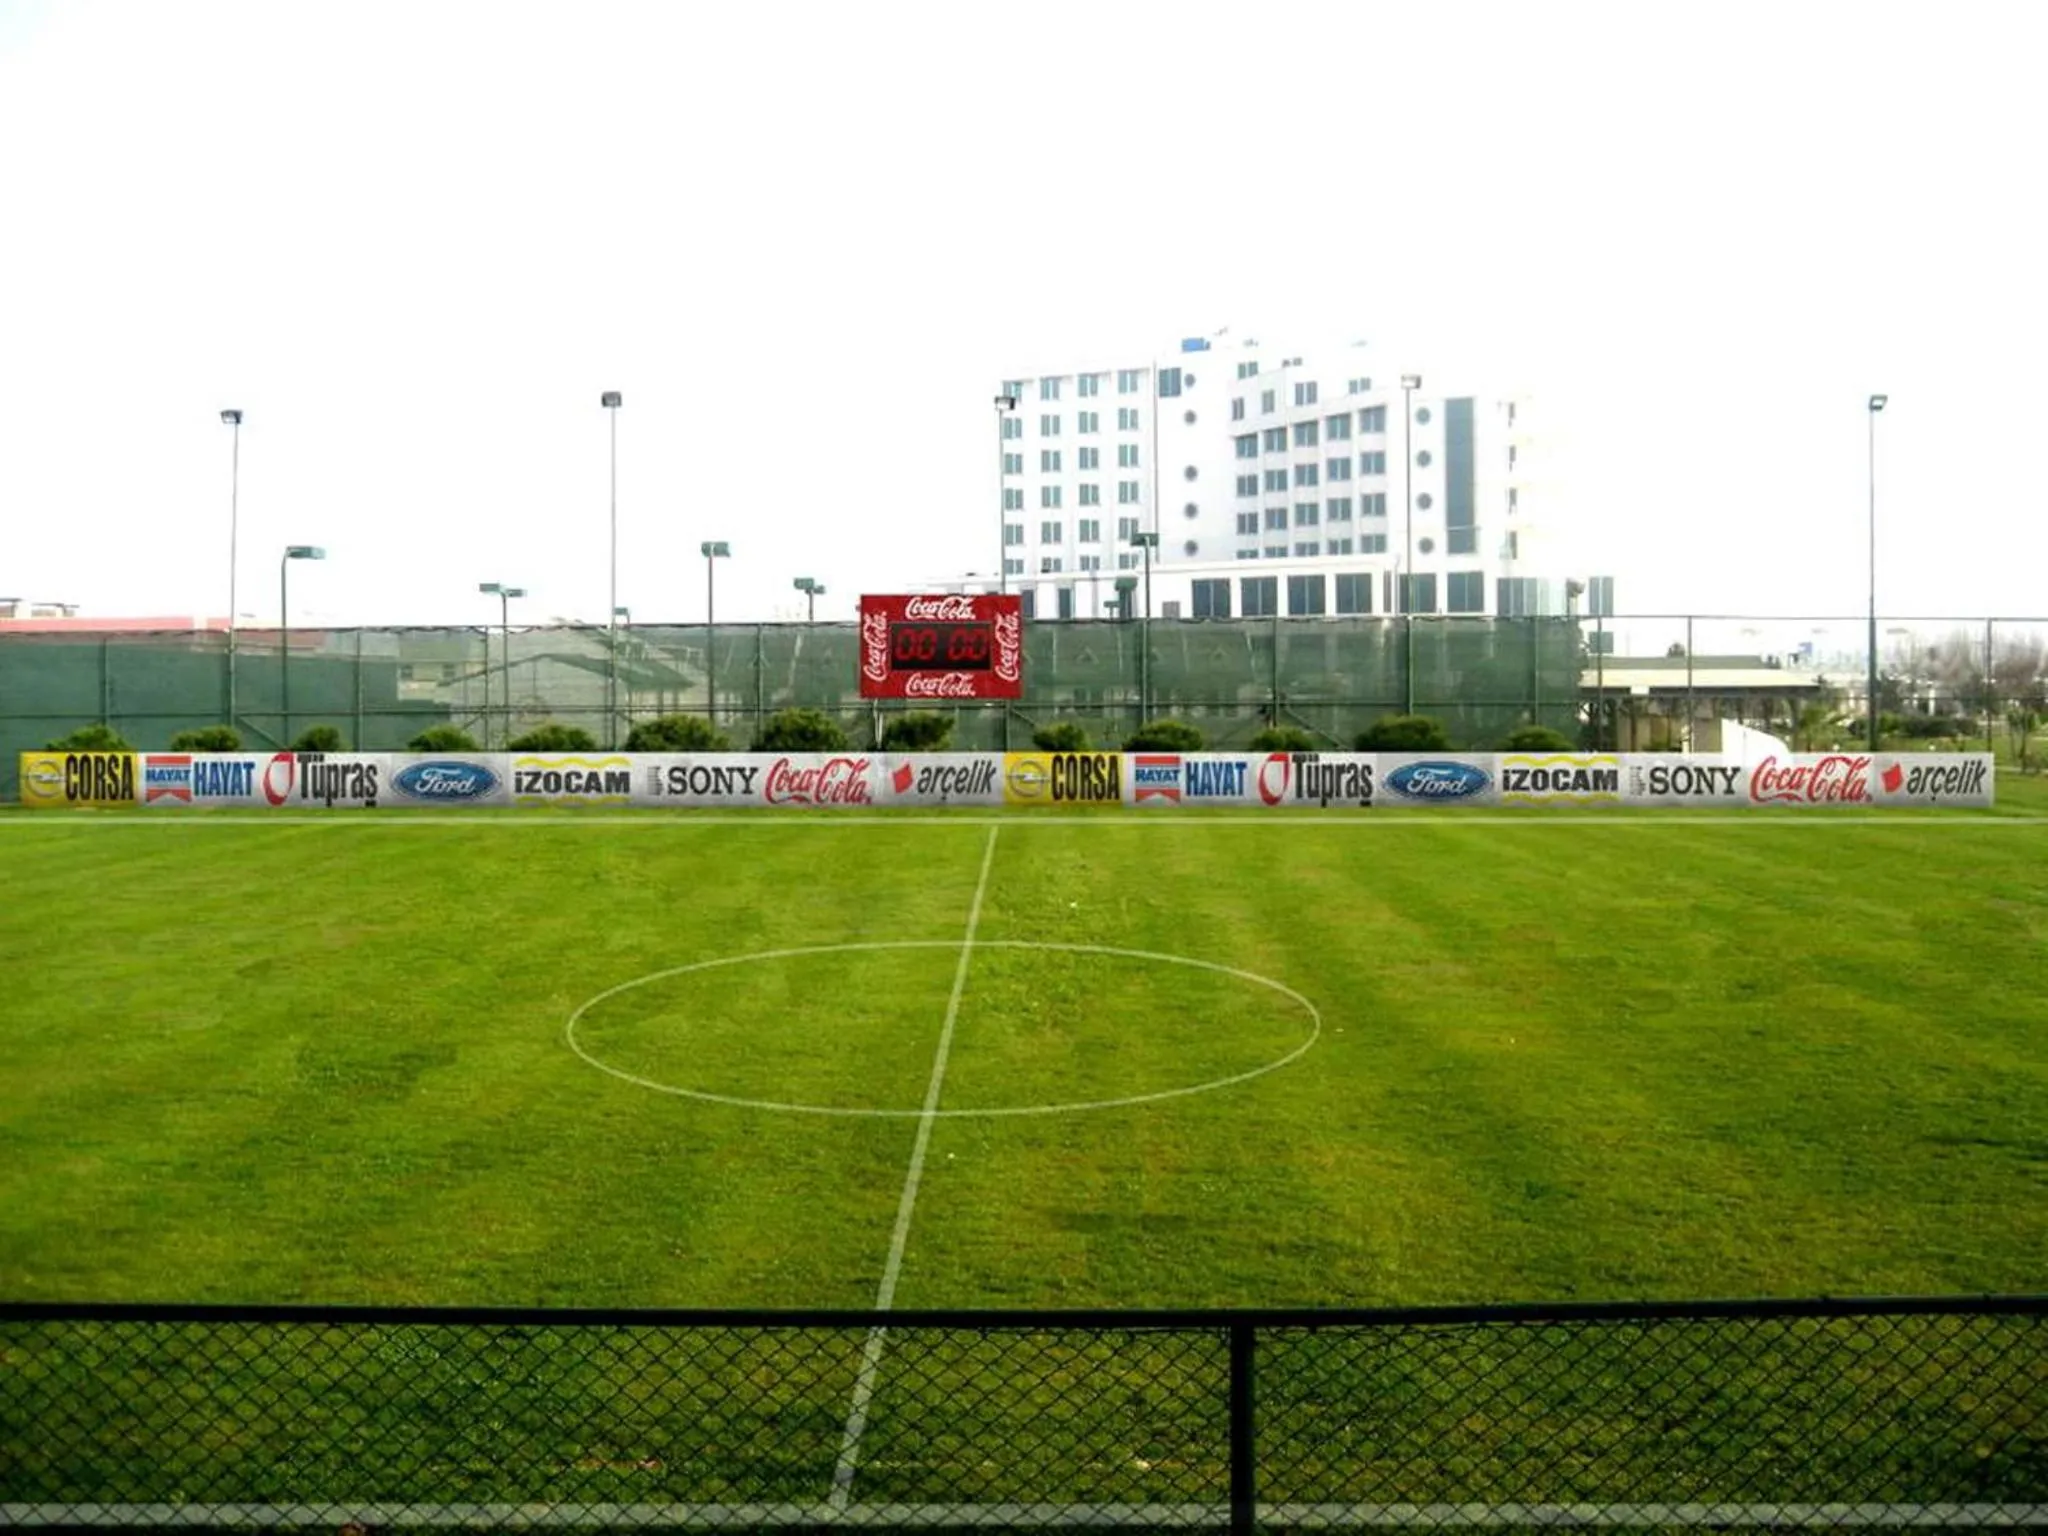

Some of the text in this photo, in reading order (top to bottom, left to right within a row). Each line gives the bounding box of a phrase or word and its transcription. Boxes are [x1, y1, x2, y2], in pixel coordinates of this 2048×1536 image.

[65, 754, 134, 800] CORSA
[147, 768, 191, 782] HAYAT
[194, 762, 255, 796] HAYAT
[298, 754, 378, 807] Tüpraş
[413, 767, 475, 793] Ford
[668, 767, 758, 795] SONY
[765, 758, 872, 805] Coca-Cola
[918, 763, 996, 803] arçelik
[1052, 754, 1119, 800] CORSA
[1136, 769, 1180, 782] HAYAT
[1186, 762, 1247, 796] HAYAT
[1292, 754, 1373, 807] Tüpraş
[1407, 767, 1468, 794] Ford
[1649, 767, 1740, 794] SONY
[1750, 756, 1872, 803] Coca-Cola
[1907, 761, 1987, 800] arçelik
